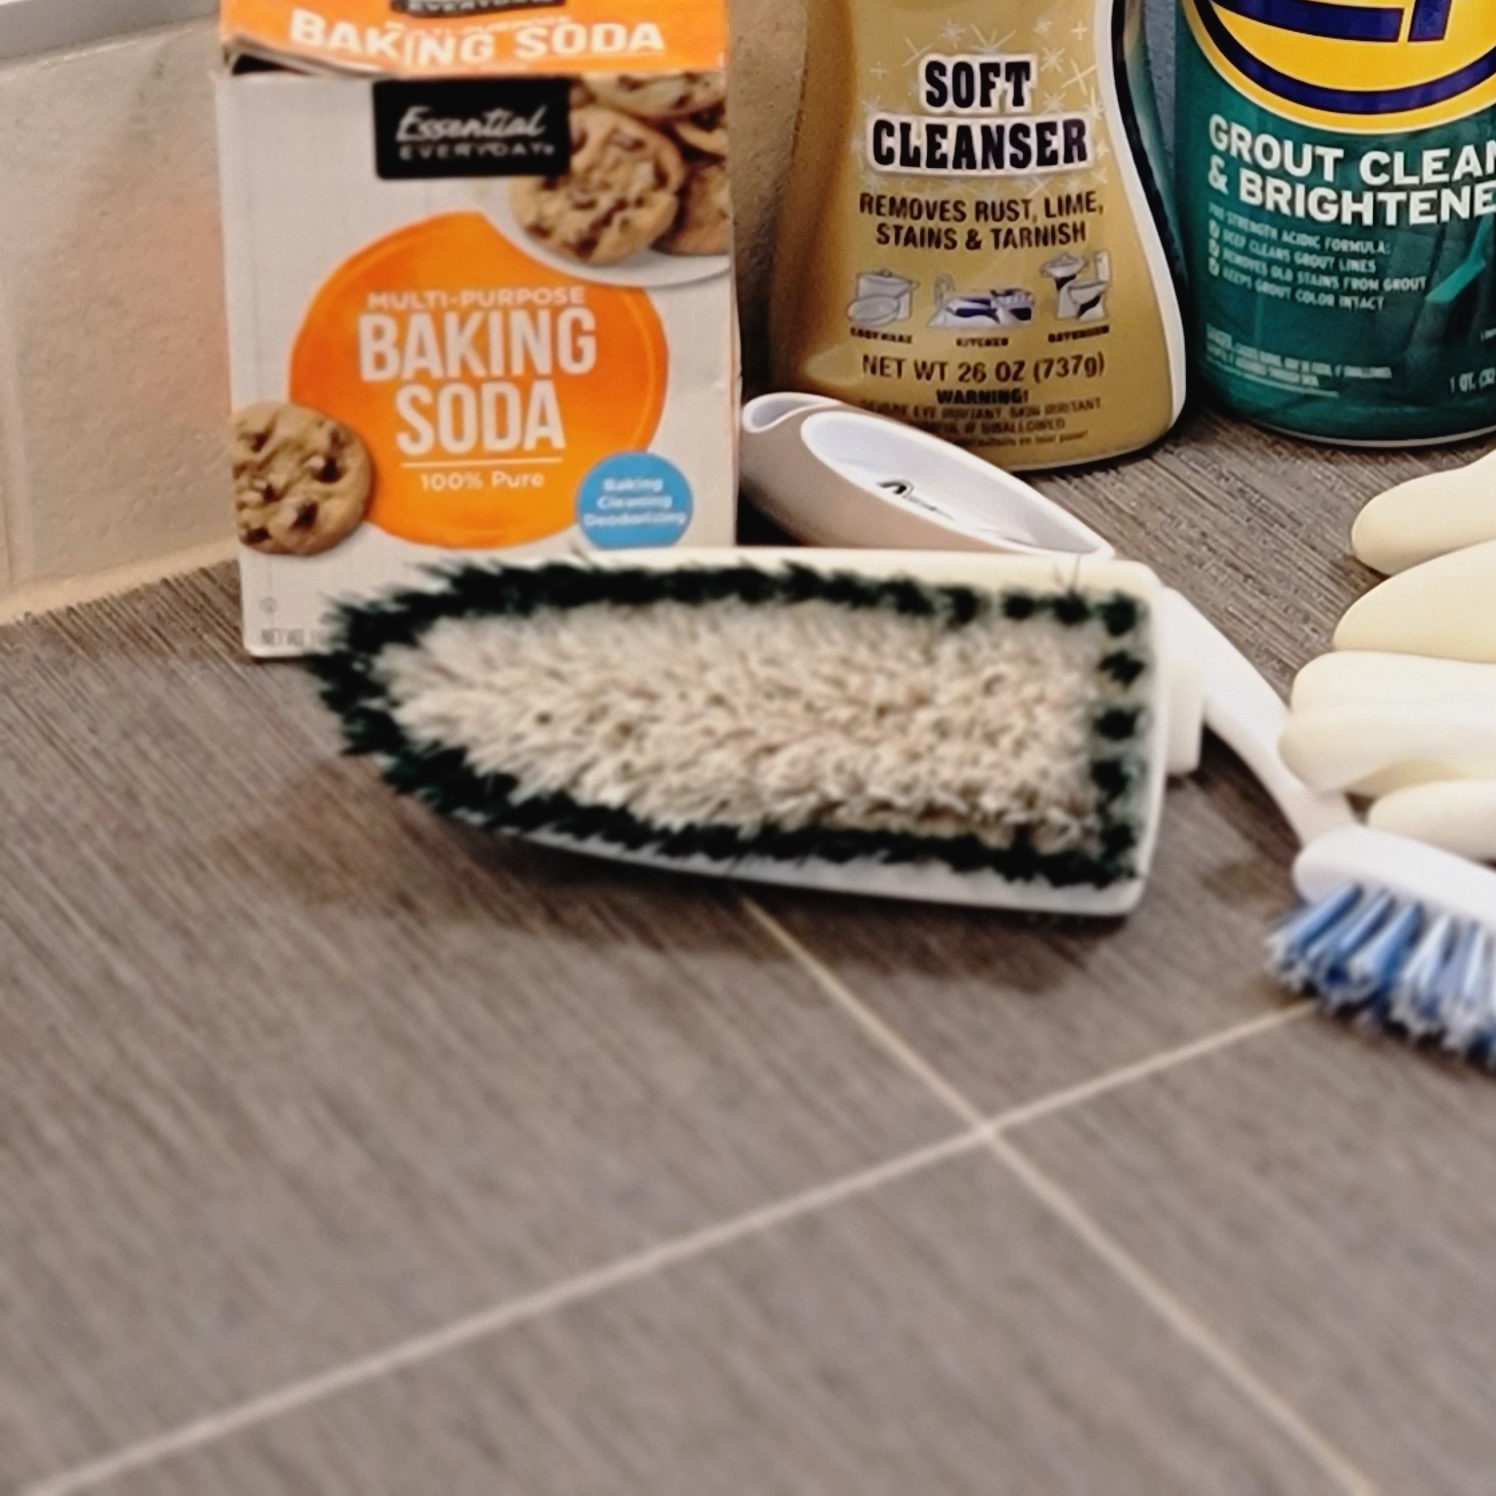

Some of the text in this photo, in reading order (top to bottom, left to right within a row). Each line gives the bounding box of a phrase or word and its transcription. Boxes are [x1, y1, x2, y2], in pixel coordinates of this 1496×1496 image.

[289, 8, 496, 66] BAKING
[515, 21, 665, 57] SODA
[924, 59, 1032, 109] SOFT
[396, 105, 548, 142] Essential
[401, 142, 554, 161] EVERYDAY
[872, 117, 1089, 171] CLEANSER
[1208, 114, 1345, 183] GROUT
[1207, 154, 1229, 195] &
[859, 190, 1104, 224] REMOVES RUST, LIME,
[875, 220, 1087, 251] STAINS & TARNISH
[1227, 210, 1278, 242] STRENGTH
[1293, 249, 1335, 270] GROUT
[1338, 257, 1377, 273] LINES
[1254, 278, 1292, 301] GROUT
[1297, 270, 1339, 290] STAINS
[1343, 275, 1379, 291] FROM
[1383, 275, 1428, 292] GROUT
[367, 286, 586, 310] MULTI-PURPOSE
[358, 306, 597, 382] BAKING
[862, 351, 1105, 384] NET WT 26 OZ (737g)
[936, 389, 1029, 406] WARNING!
[394, 379, 567, 456] SODA
[420, 470, 545, 492] 100% Pure
